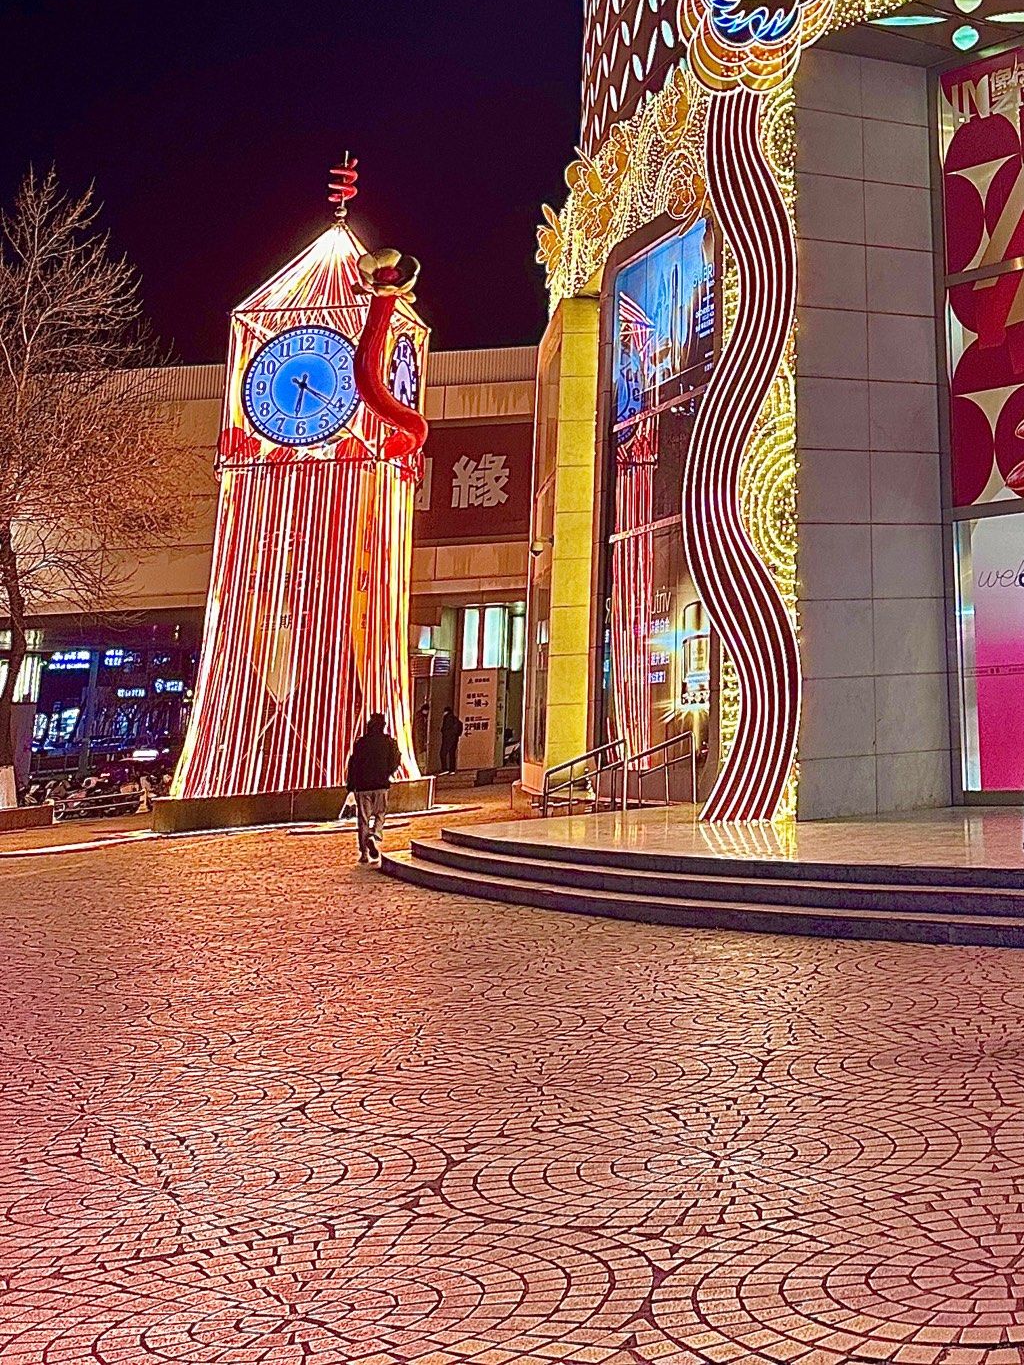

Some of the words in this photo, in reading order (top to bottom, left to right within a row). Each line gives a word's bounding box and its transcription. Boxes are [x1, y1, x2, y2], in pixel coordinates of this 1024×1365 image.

[279, 342, 291, 358] 11
[298, 336, 315, 351] 12
[323, 340, 330, 354] 1
[260, 360, 276, 376] 10
[338, 355, 349, 371] 2
[256, 380, 267, 396] 9
[341, 375, 352, 391] 3
[260, 401, 271, 417] 8
[275, 417, 287, 434] 7
[295, 420, 307, 436] 6
[318, 412, 330, 430] 5
